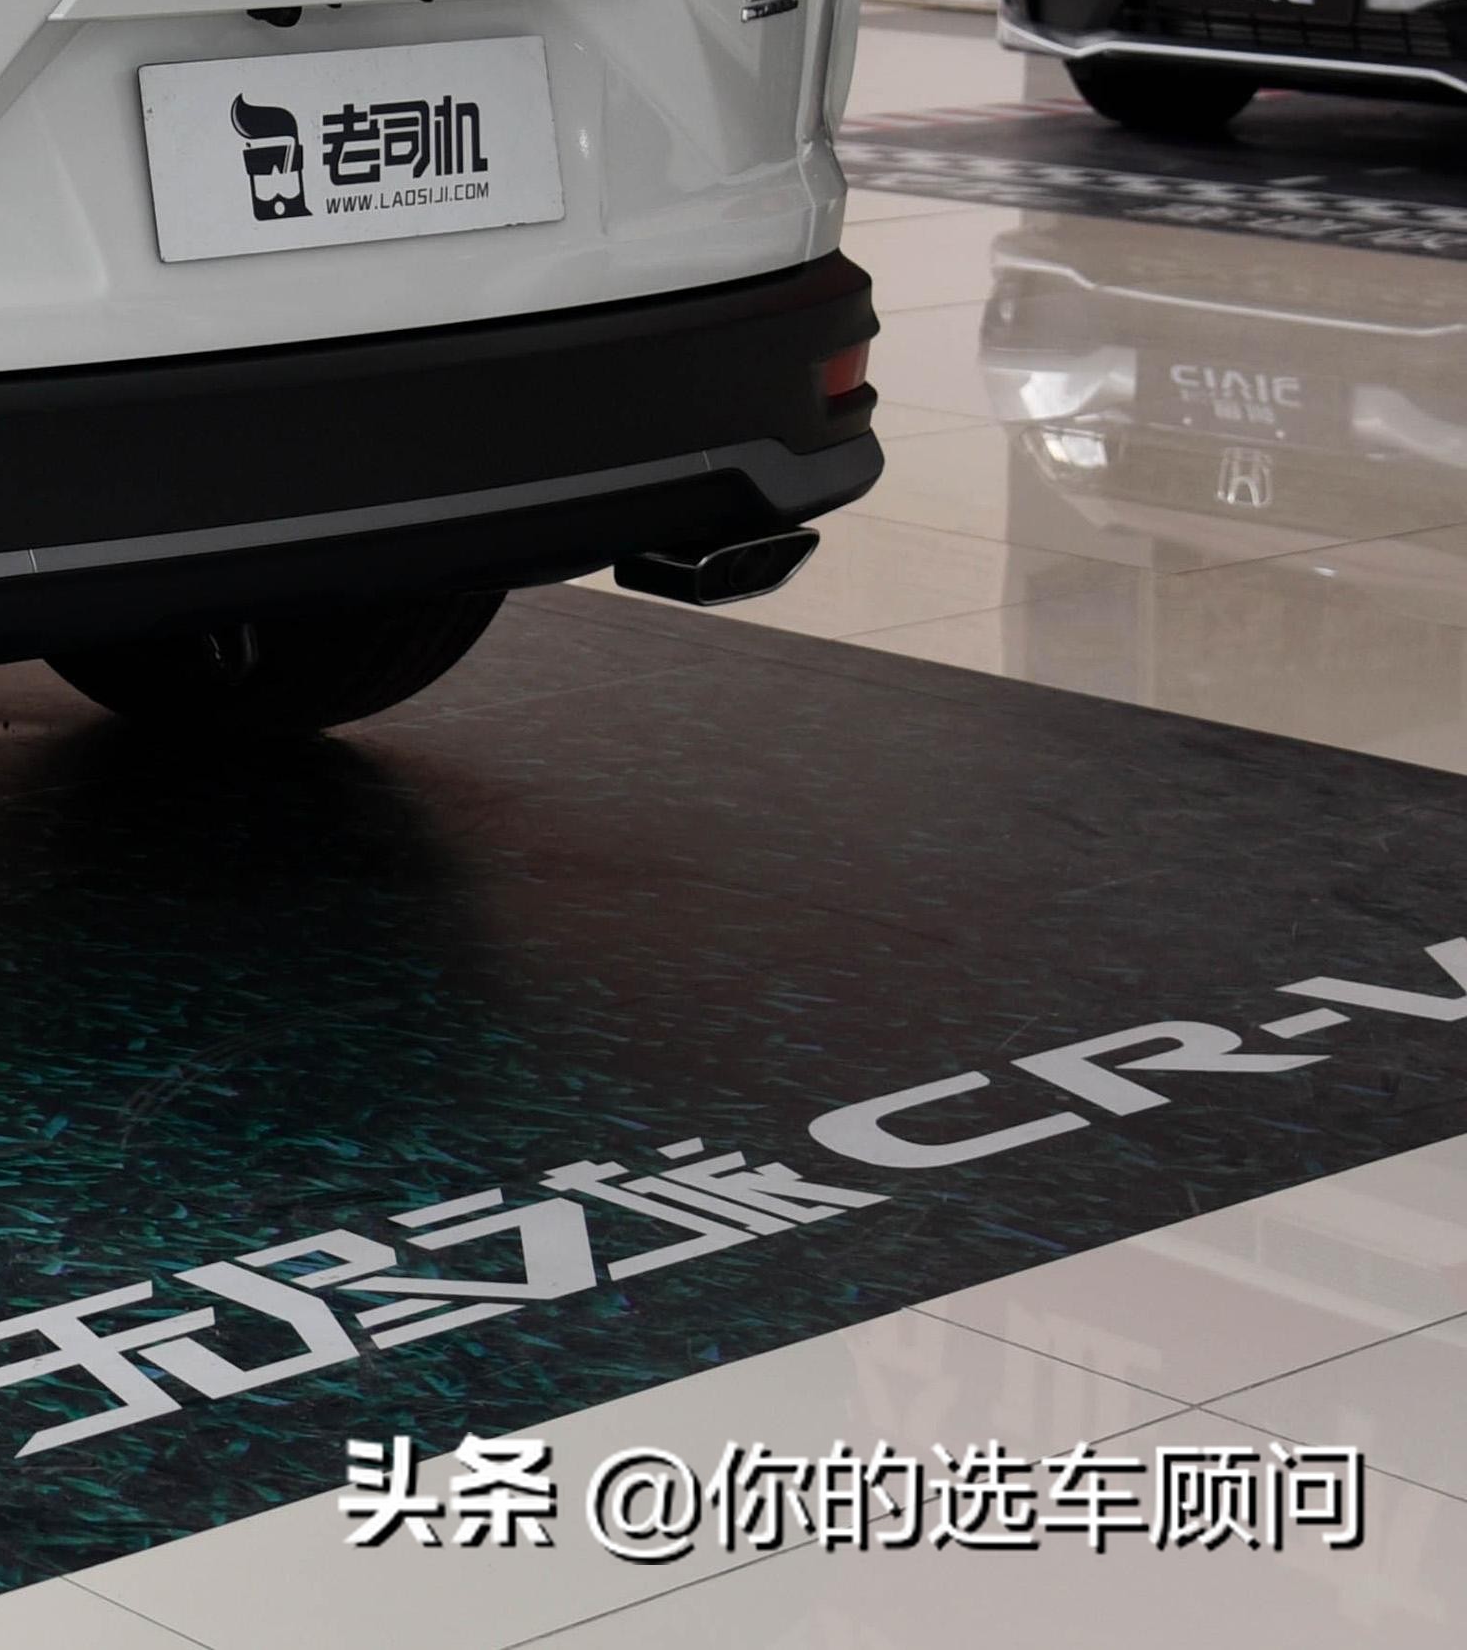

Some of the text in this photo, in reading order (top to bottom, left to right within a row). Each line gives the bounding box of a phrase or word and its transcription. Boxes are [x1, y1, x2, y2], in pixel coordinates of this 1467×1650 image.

[322, 94, 489, 187] 老司机
[325, 181, 490, 215] WWW.LAOSIJI.COM
